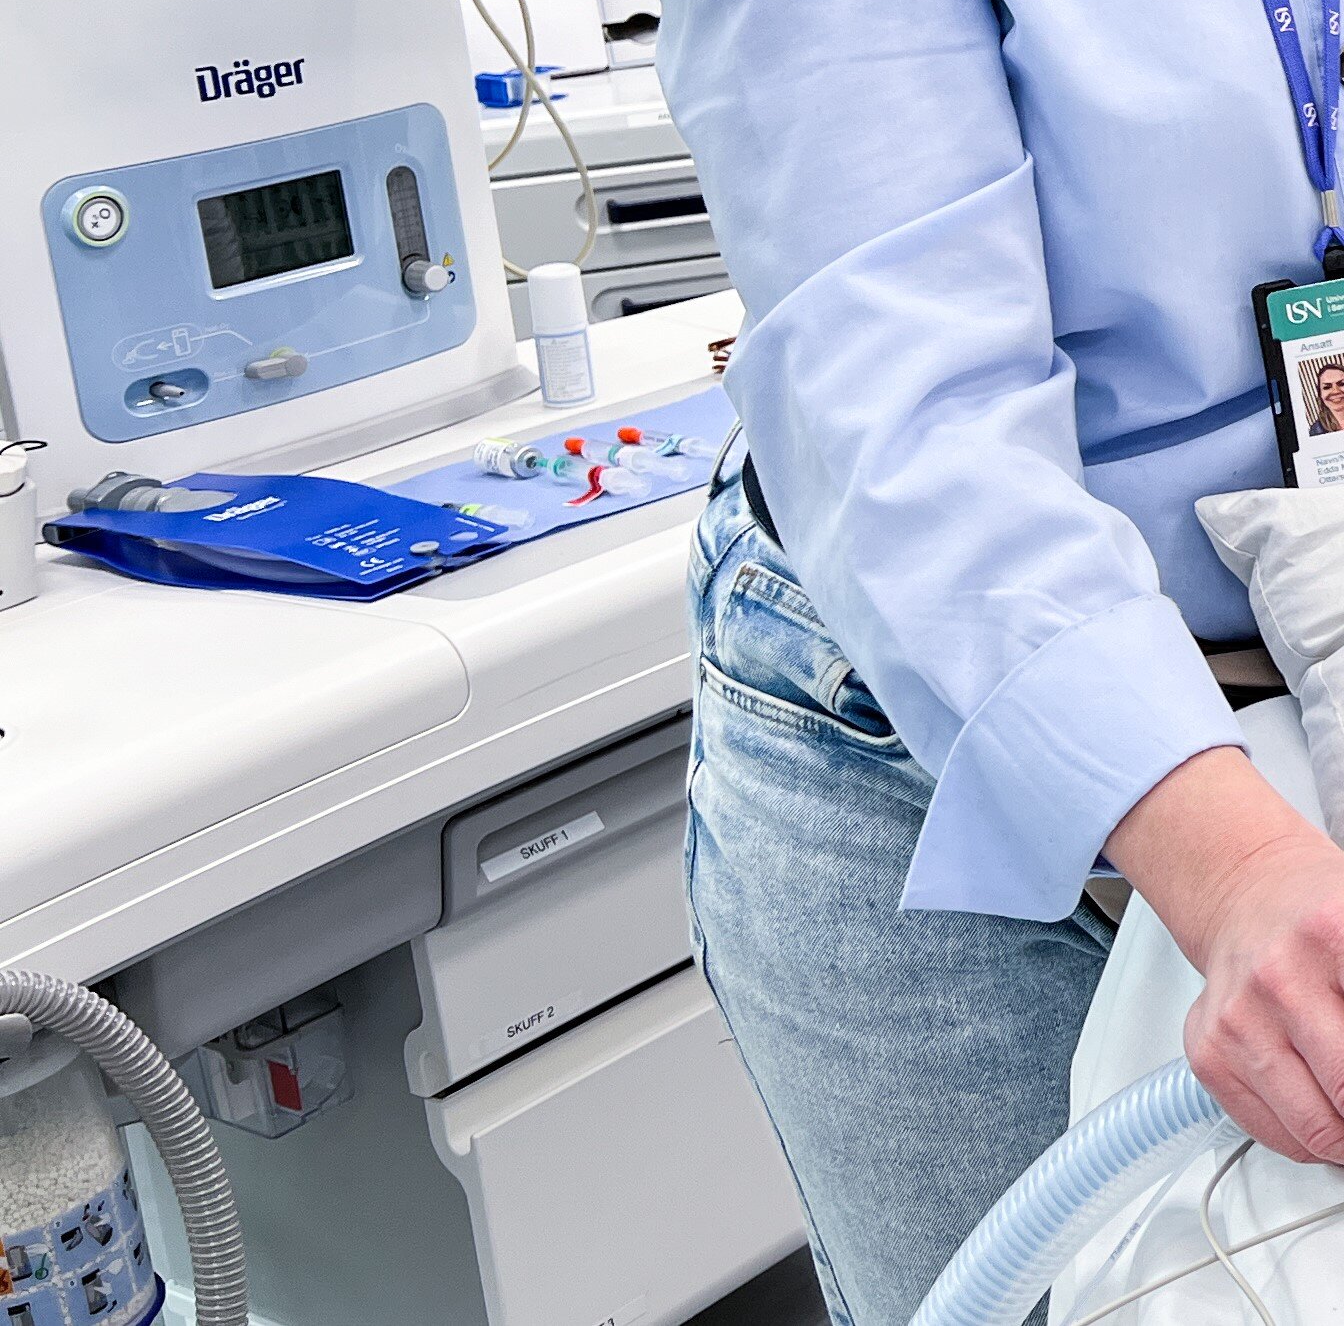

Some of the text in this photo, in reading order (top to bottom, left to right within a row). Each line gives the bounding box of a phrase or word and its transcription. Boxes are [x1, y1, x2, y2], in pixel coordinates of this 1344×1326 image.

[195, 58, 304, 102] Dräger
[1285, 298, 1322, 324] USN
[1301, 338, 1334, 353] Ansatt
[520, 829, 570, 860] SKUFF 1
[506, 1005, 556, 1039] SKUFF 2
